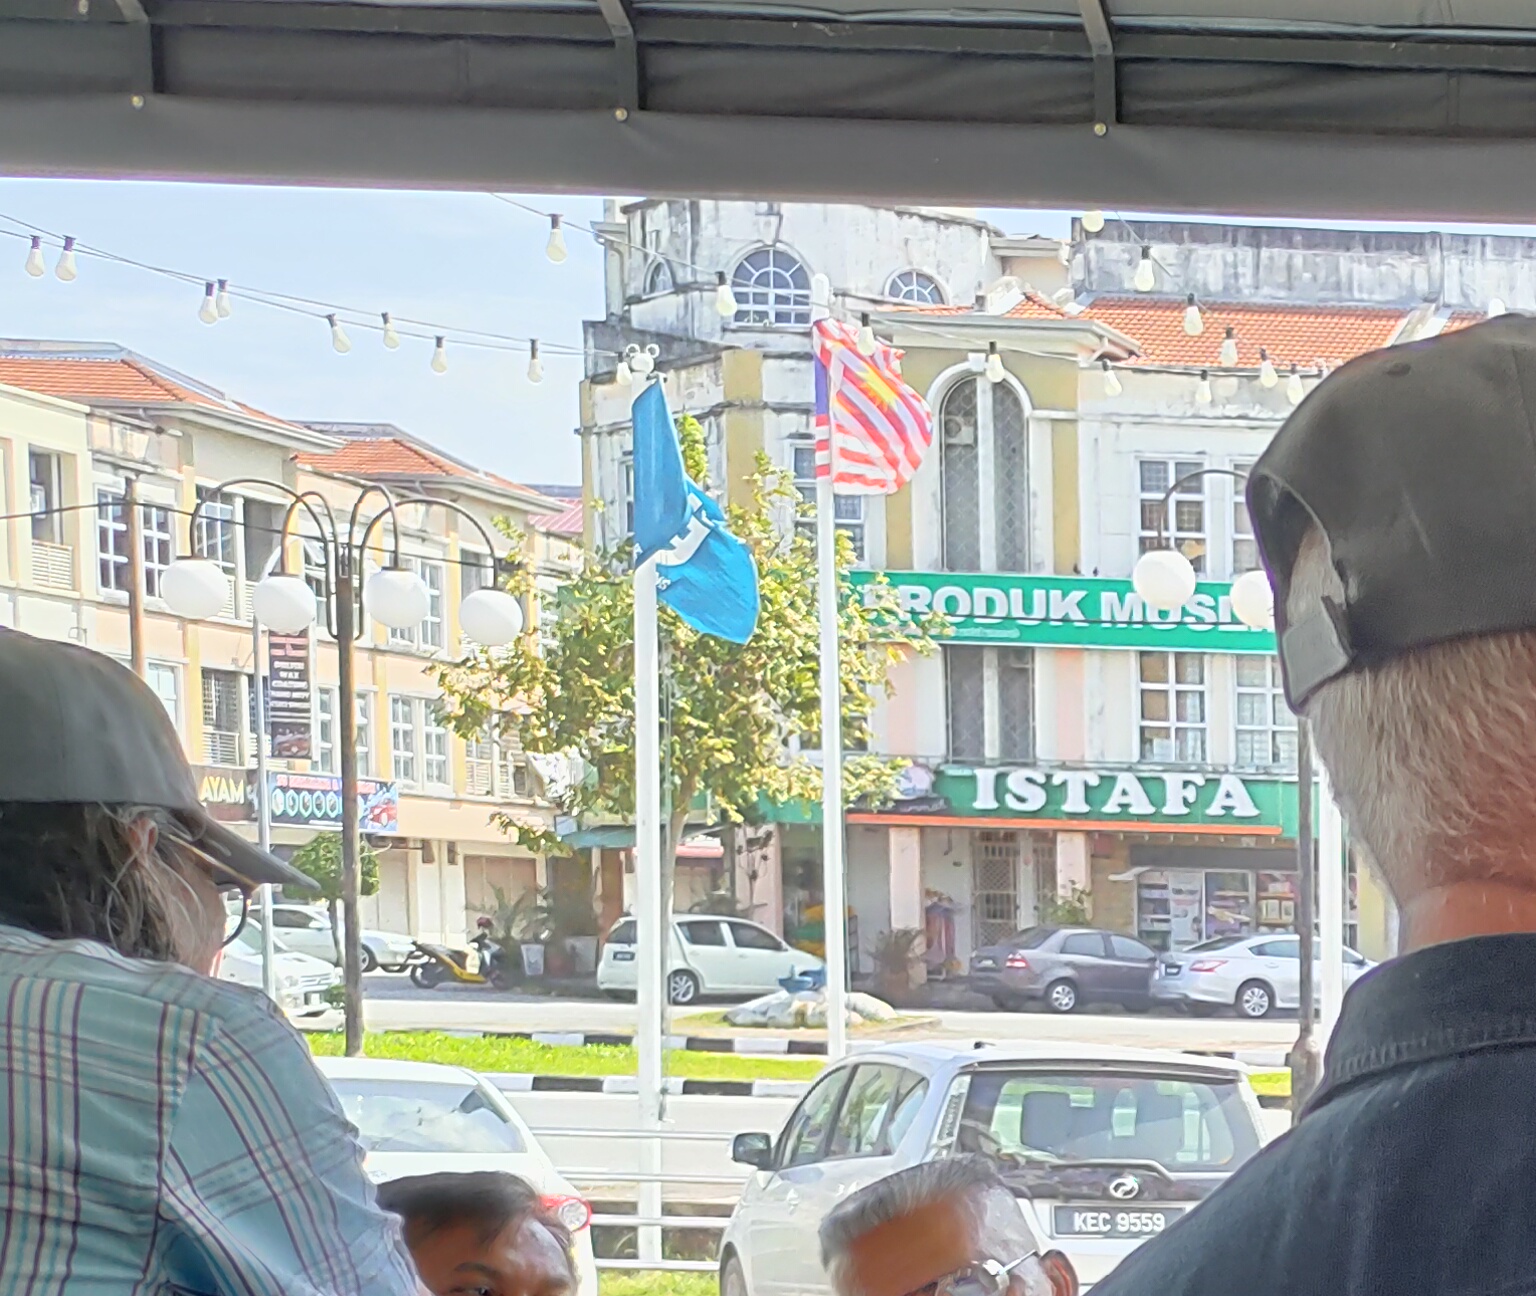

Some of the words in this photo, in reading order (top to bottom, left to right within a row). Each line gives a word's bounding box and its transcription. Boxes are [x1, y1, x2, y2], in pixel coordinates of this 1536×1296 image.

[973, 768, 1261, 818] ISTAFA
[1073, 1212, 1112, 1233] KEC
[1115, 1212, 1166, 1233] 9559
